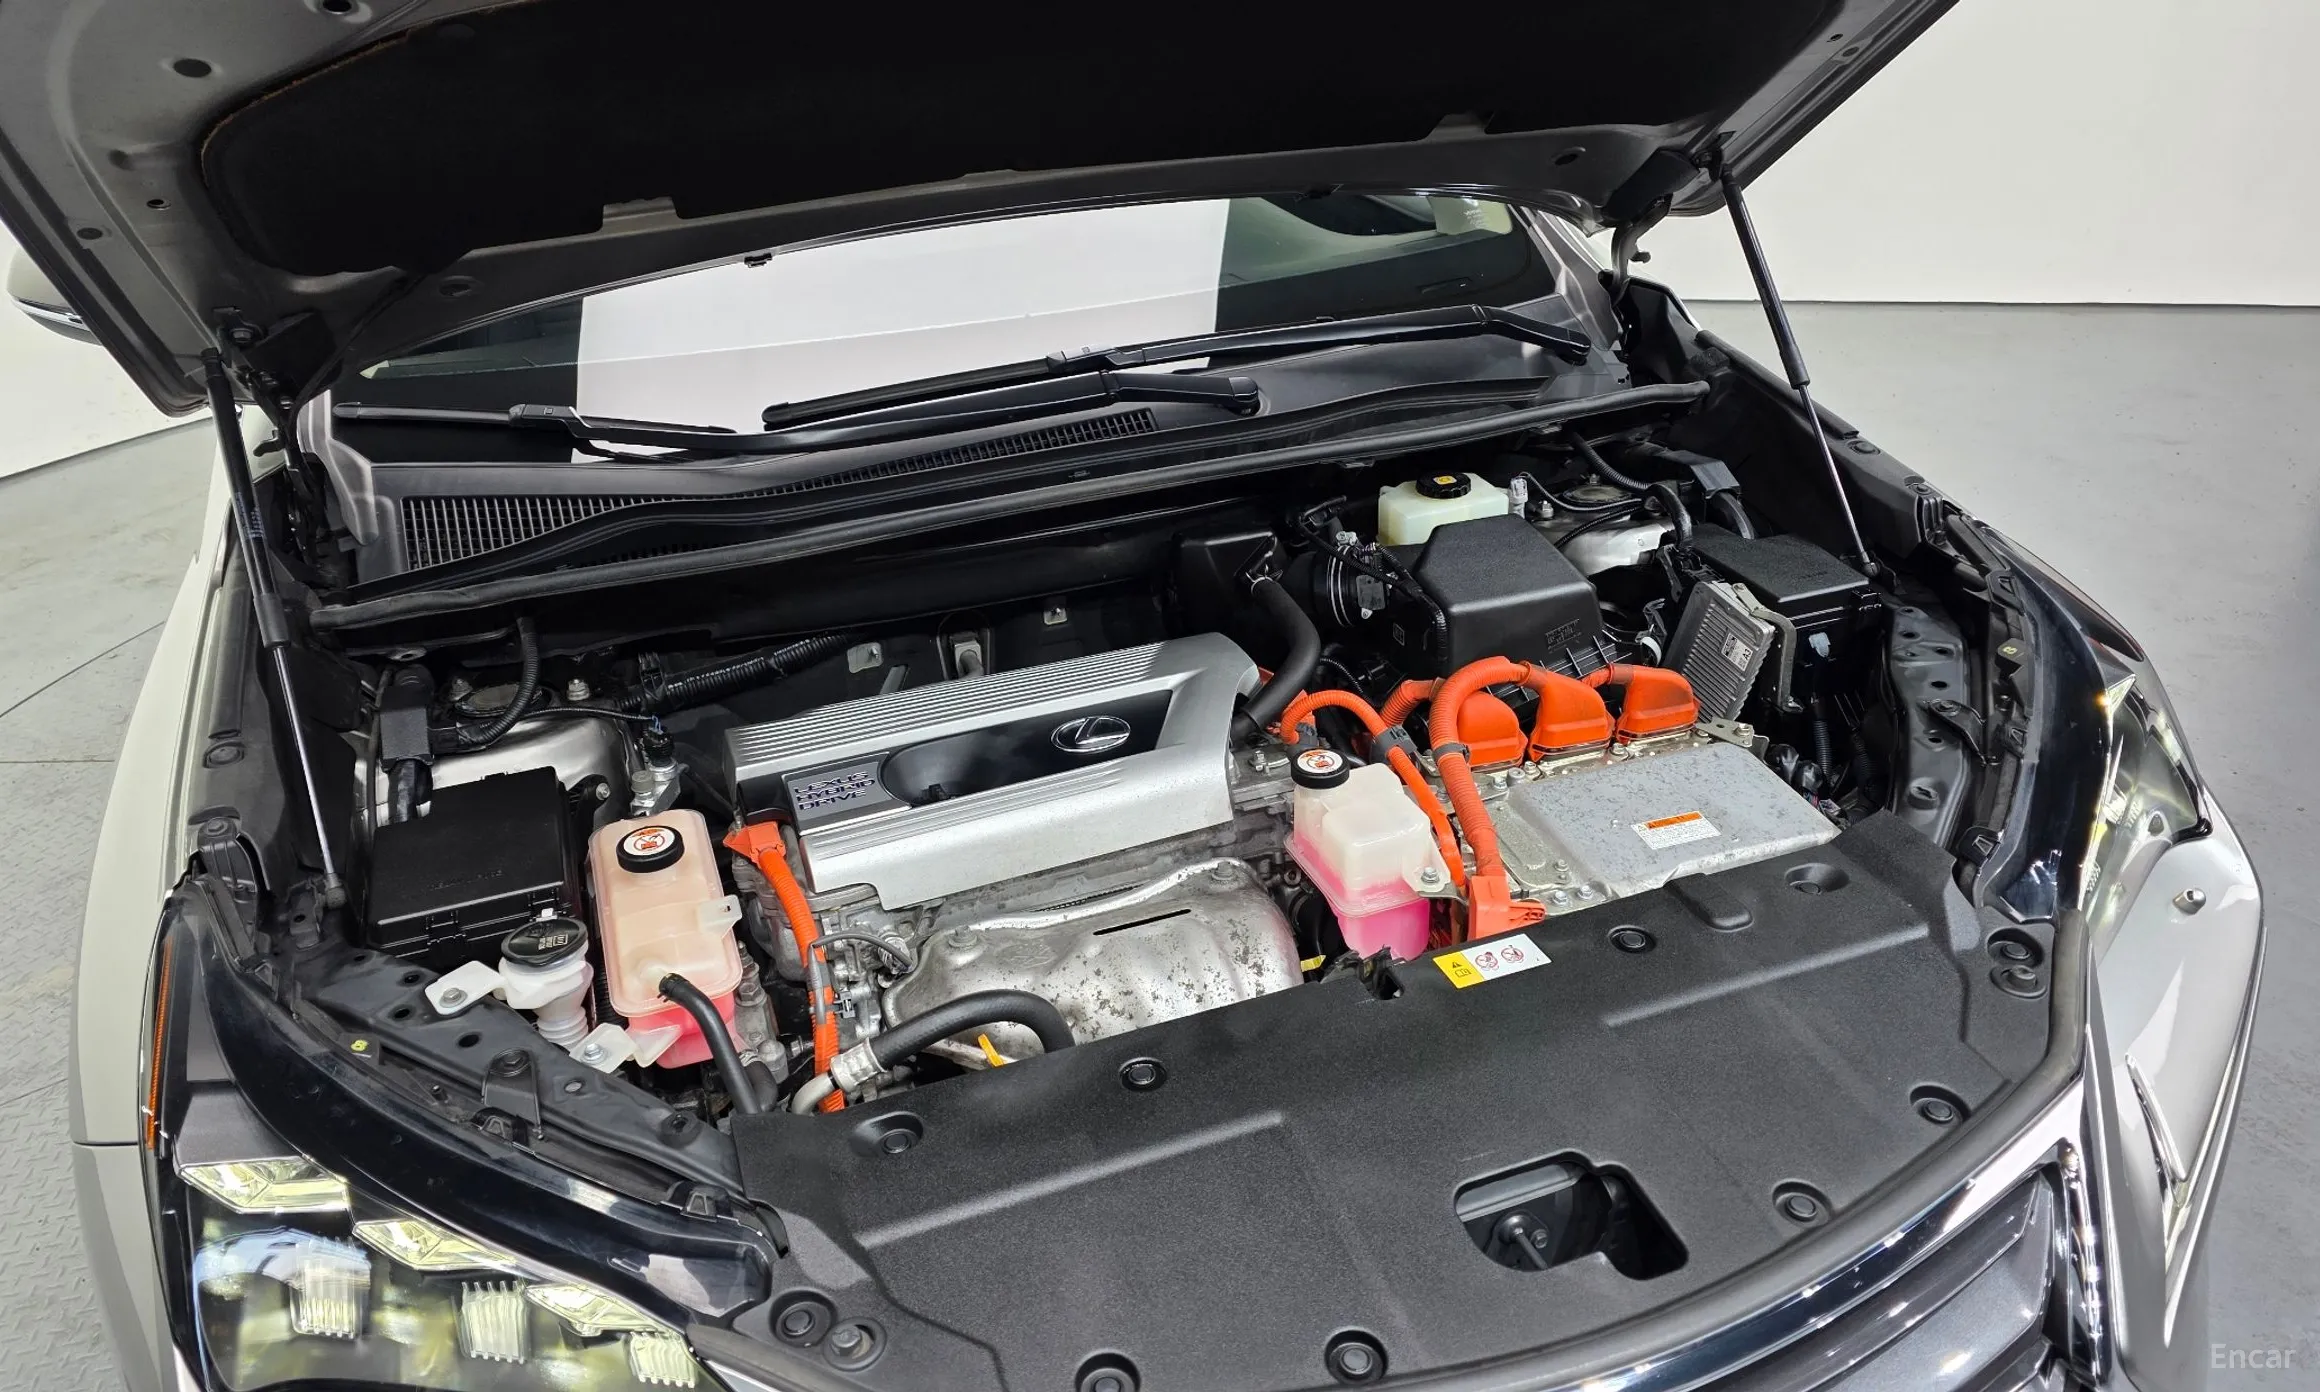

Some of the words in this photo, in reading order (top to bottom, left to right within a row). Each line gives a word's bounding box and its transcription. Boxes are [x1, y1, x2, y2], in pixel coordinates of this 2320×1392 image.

[794, 771, 868, 793] LEXUS
[796, 779, 875, 801] HYBRID
[799, 789, 867, 810] DRIVE
